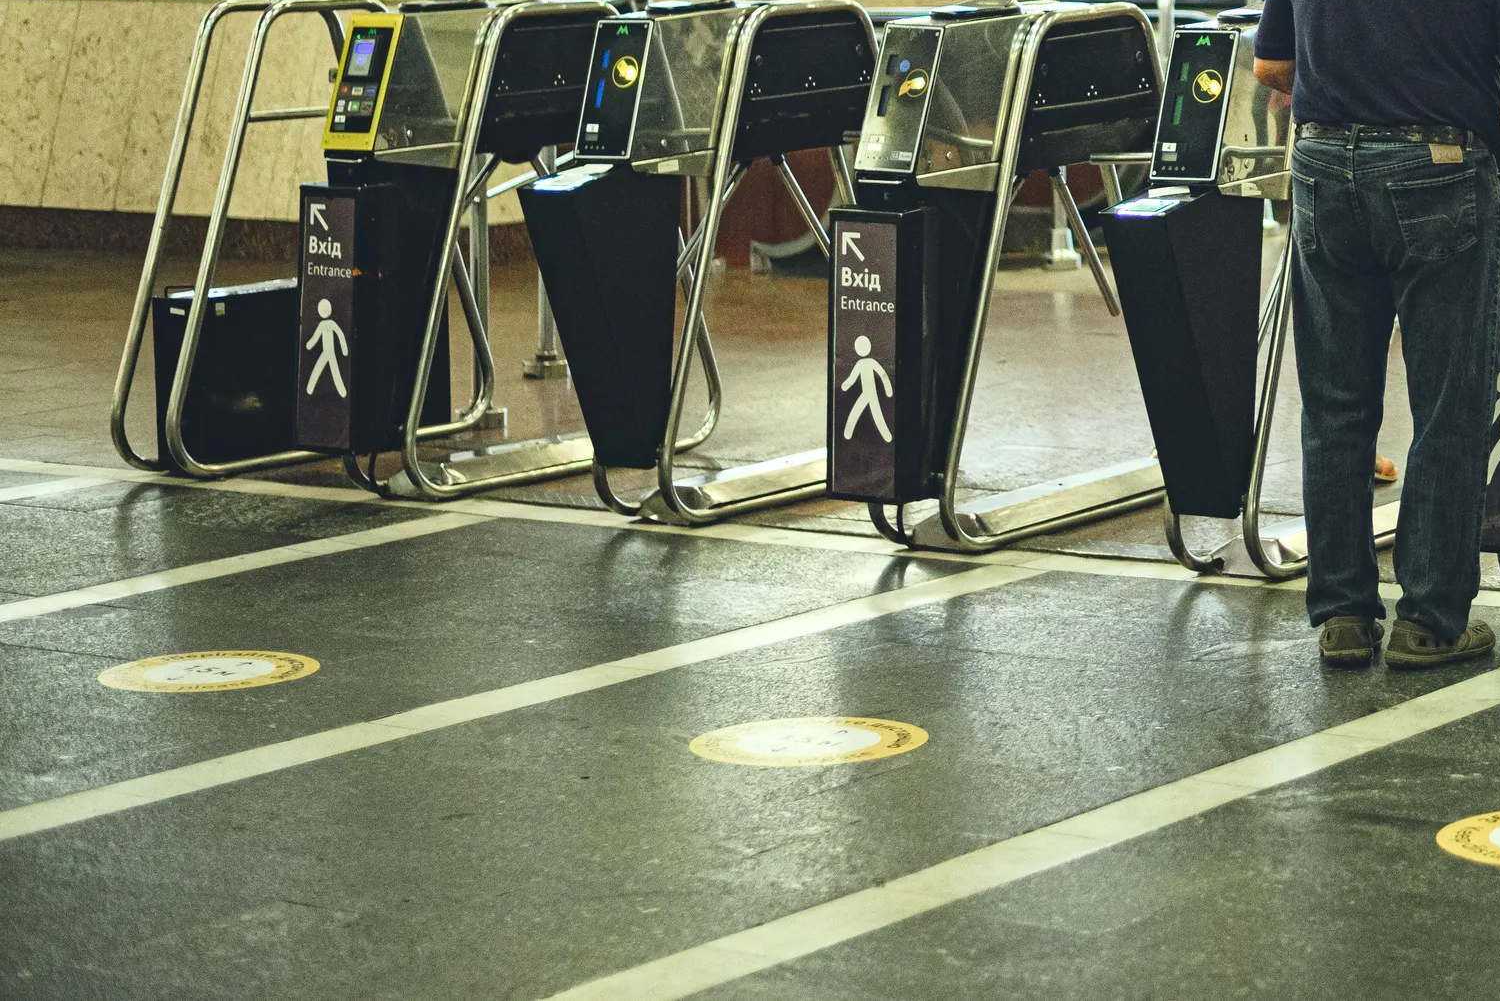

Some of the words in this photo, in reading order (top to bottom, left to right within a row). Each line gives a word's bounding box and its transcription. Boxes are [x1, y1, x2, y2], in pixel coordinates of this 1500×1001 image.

[308, 235, 342, 259] Вхід
[307, 262, 352, 279] Entrance
[841, 266, 881, 292] Вхід
[841, 295, 895, 313] Entrance
